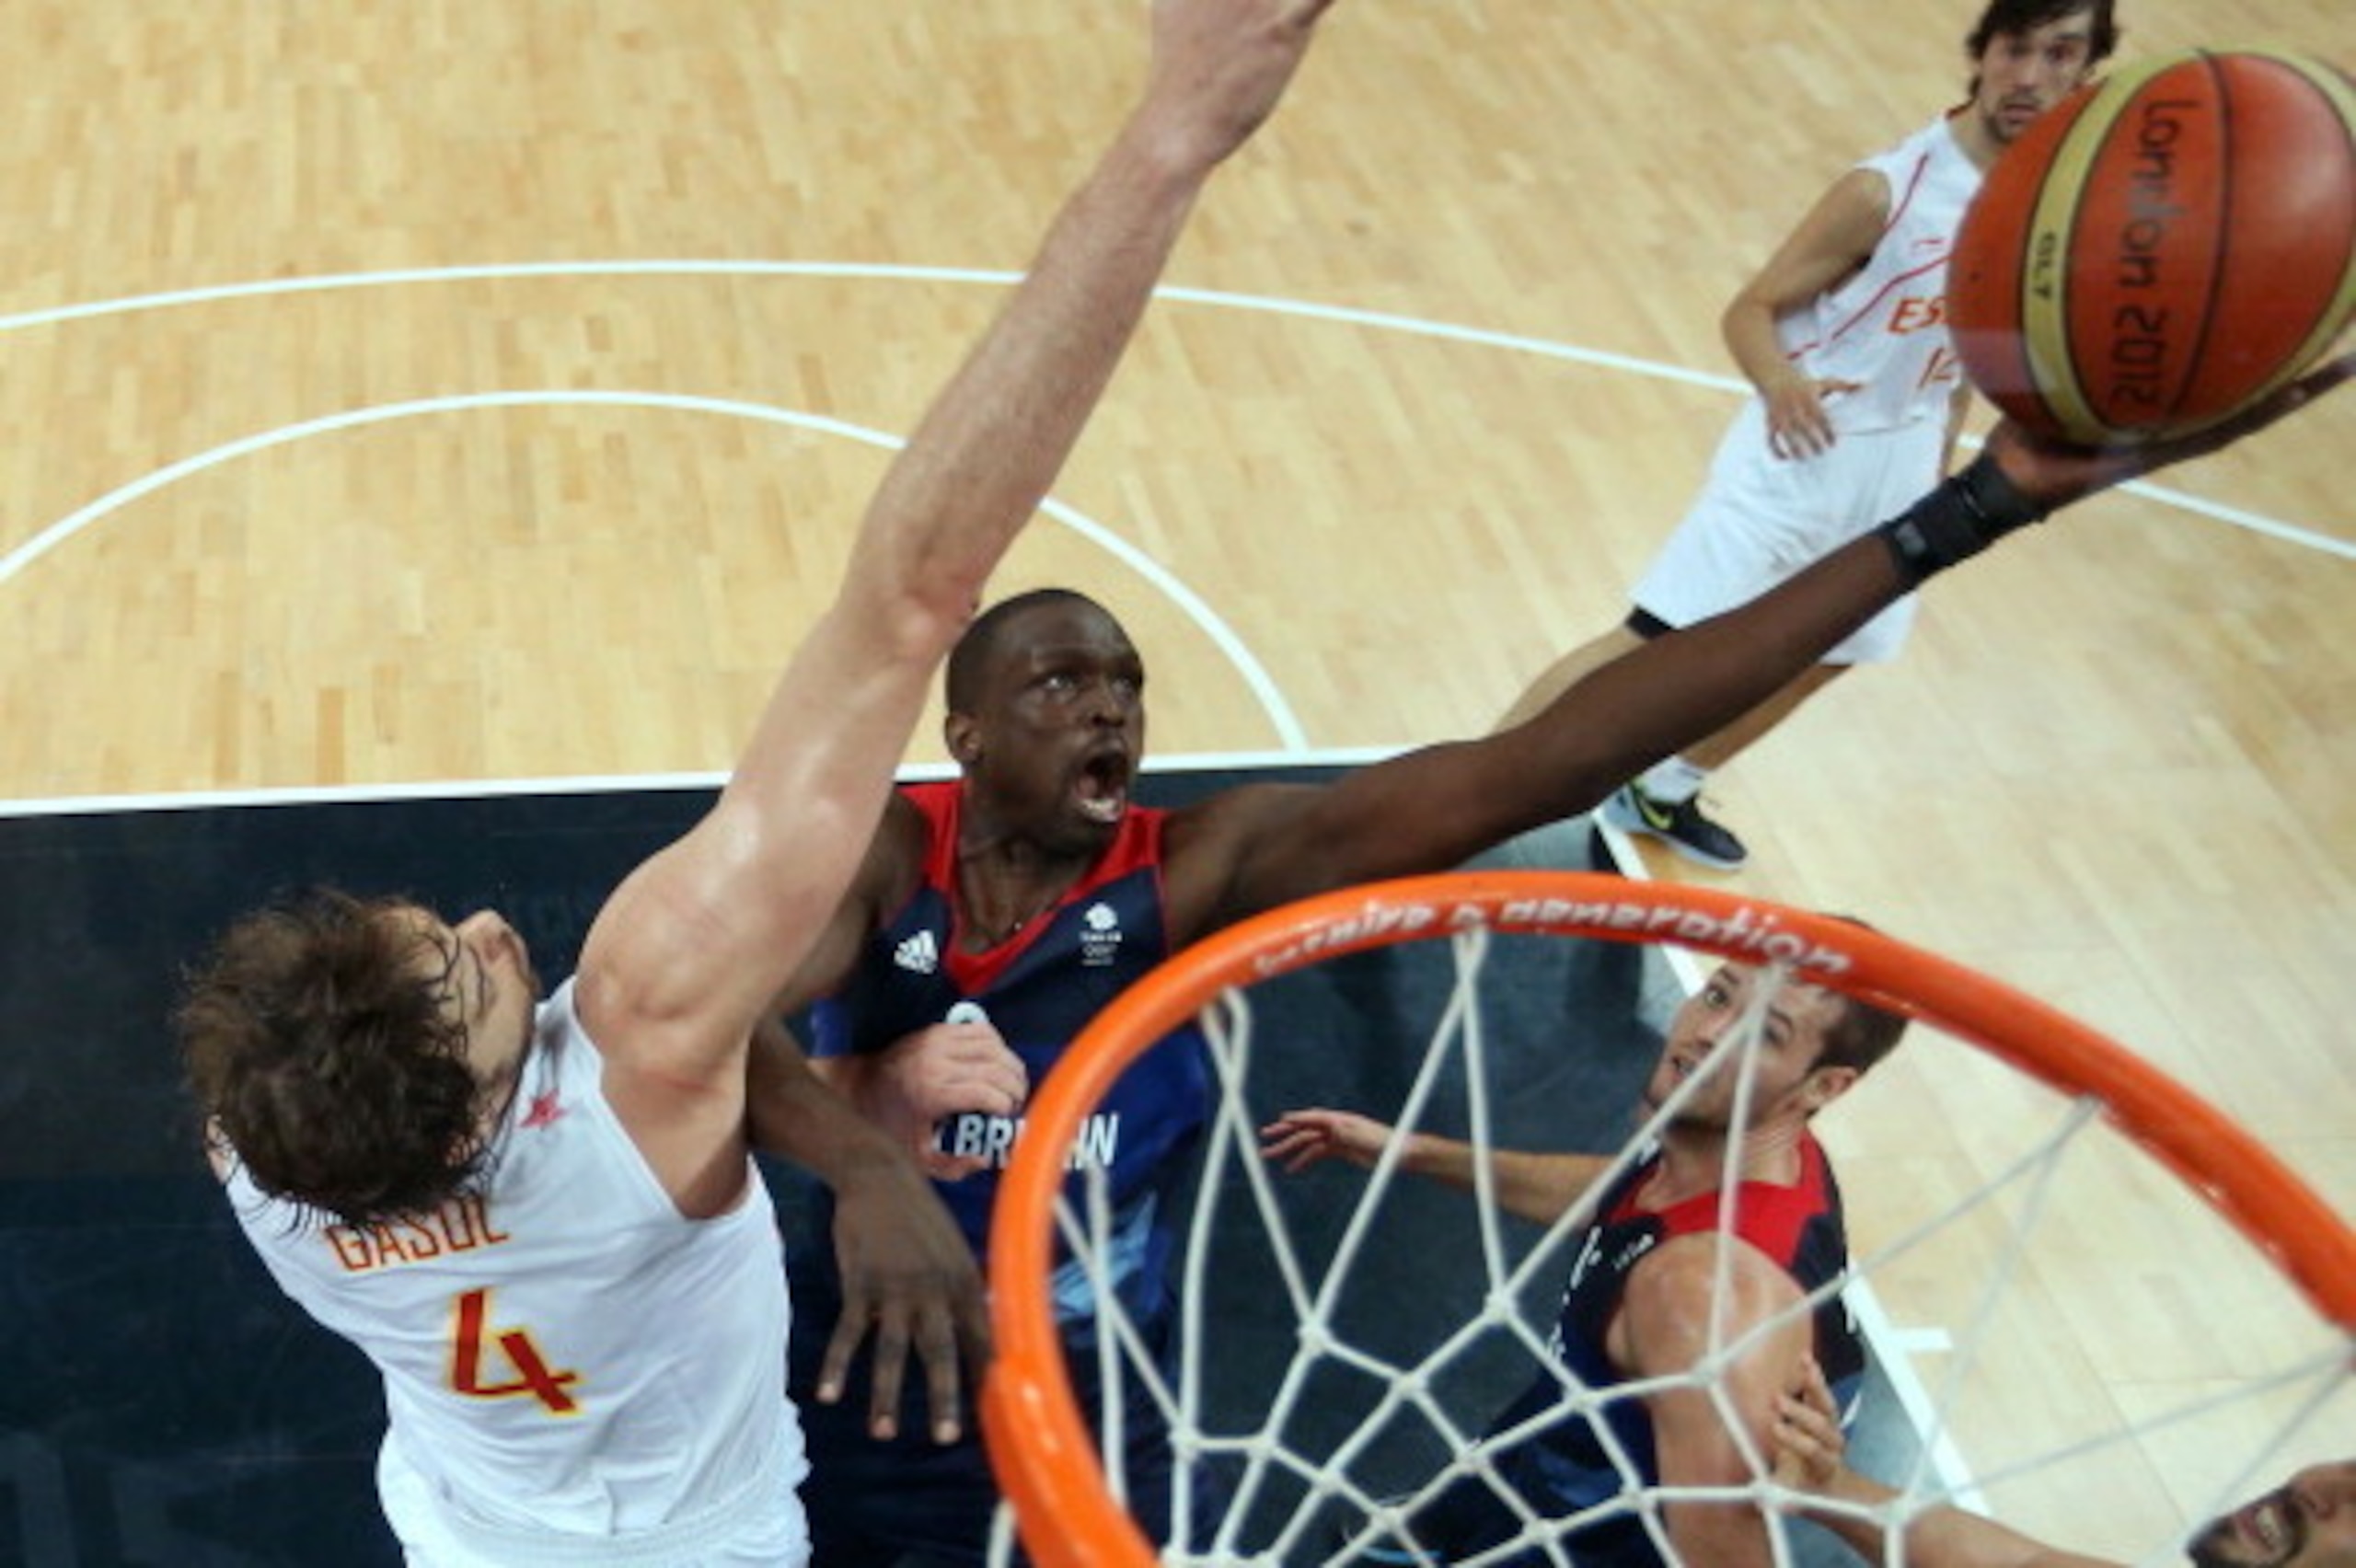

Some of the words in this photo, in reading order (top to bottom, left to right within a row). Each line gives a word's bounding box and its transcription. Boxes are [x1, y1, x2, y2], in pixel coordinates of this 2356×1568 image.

[1888, 296, 1948, 335] ES
[2110, 305, 2170, 406] 2012
[953, 1112, 1120, 1171] BRIN
[326, 1198, 509, 1271] GASOL
[451, 1285, 583, 1414] 4
